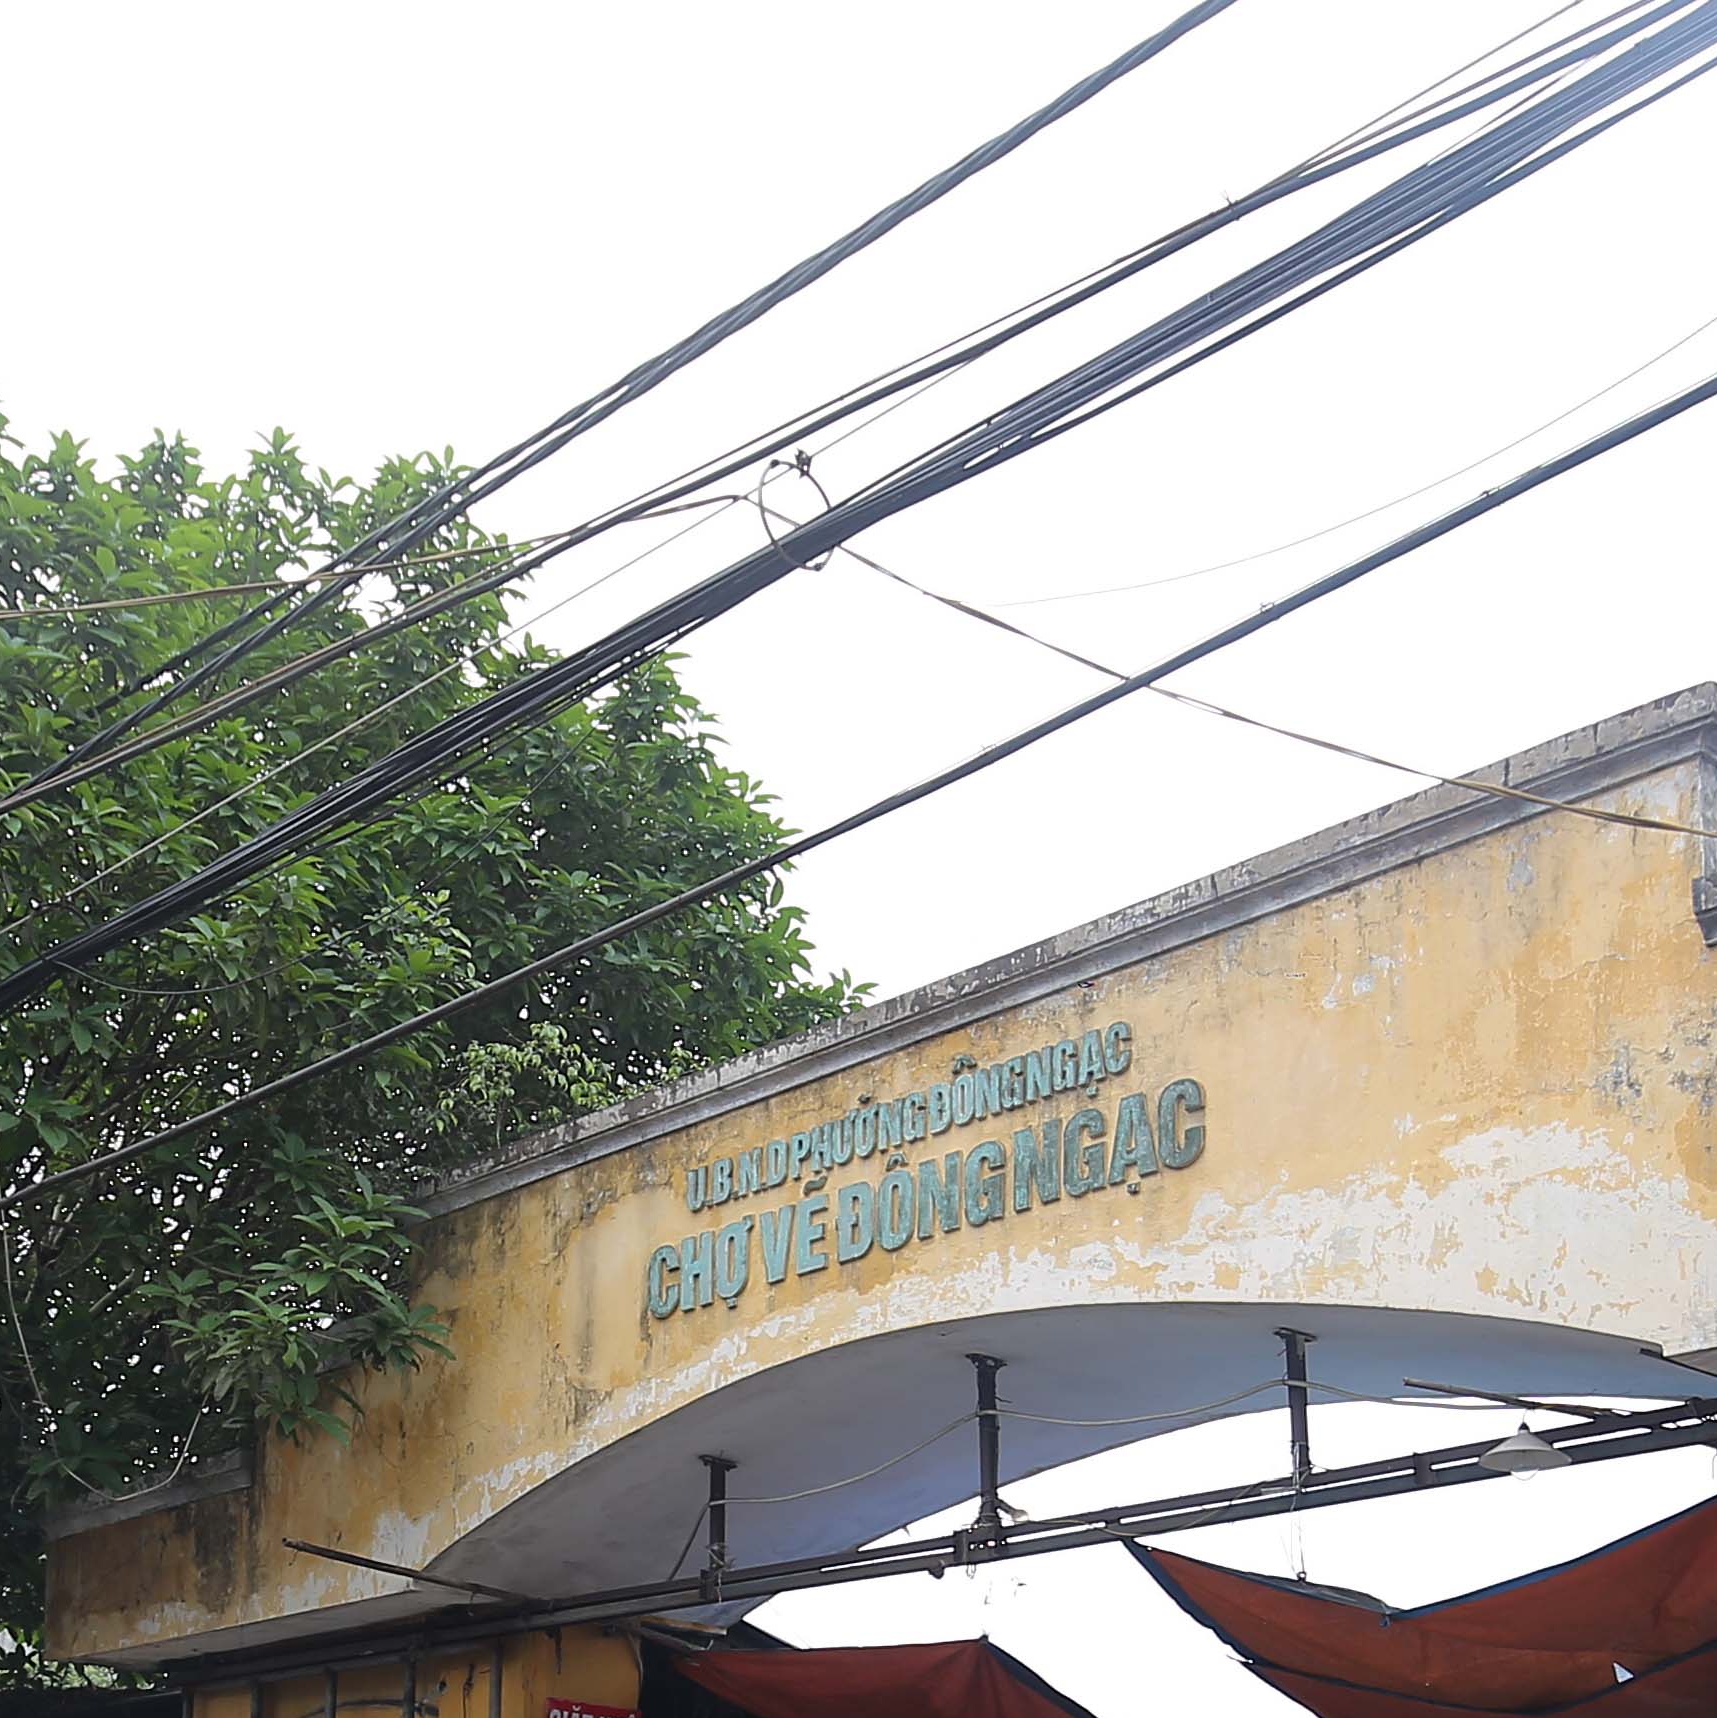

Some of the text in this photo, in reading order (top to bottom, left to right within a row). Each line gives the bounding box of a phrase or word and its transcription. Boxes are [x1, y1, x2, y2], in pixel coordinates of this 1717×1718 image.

[648, 1078, 1206, 1319] CHỢ VẼ ĐÔNG NGẠC
[687, 1020, 1133, 1212] U.B.N.D PHƯỜNG ĐÔNG NGẠC
